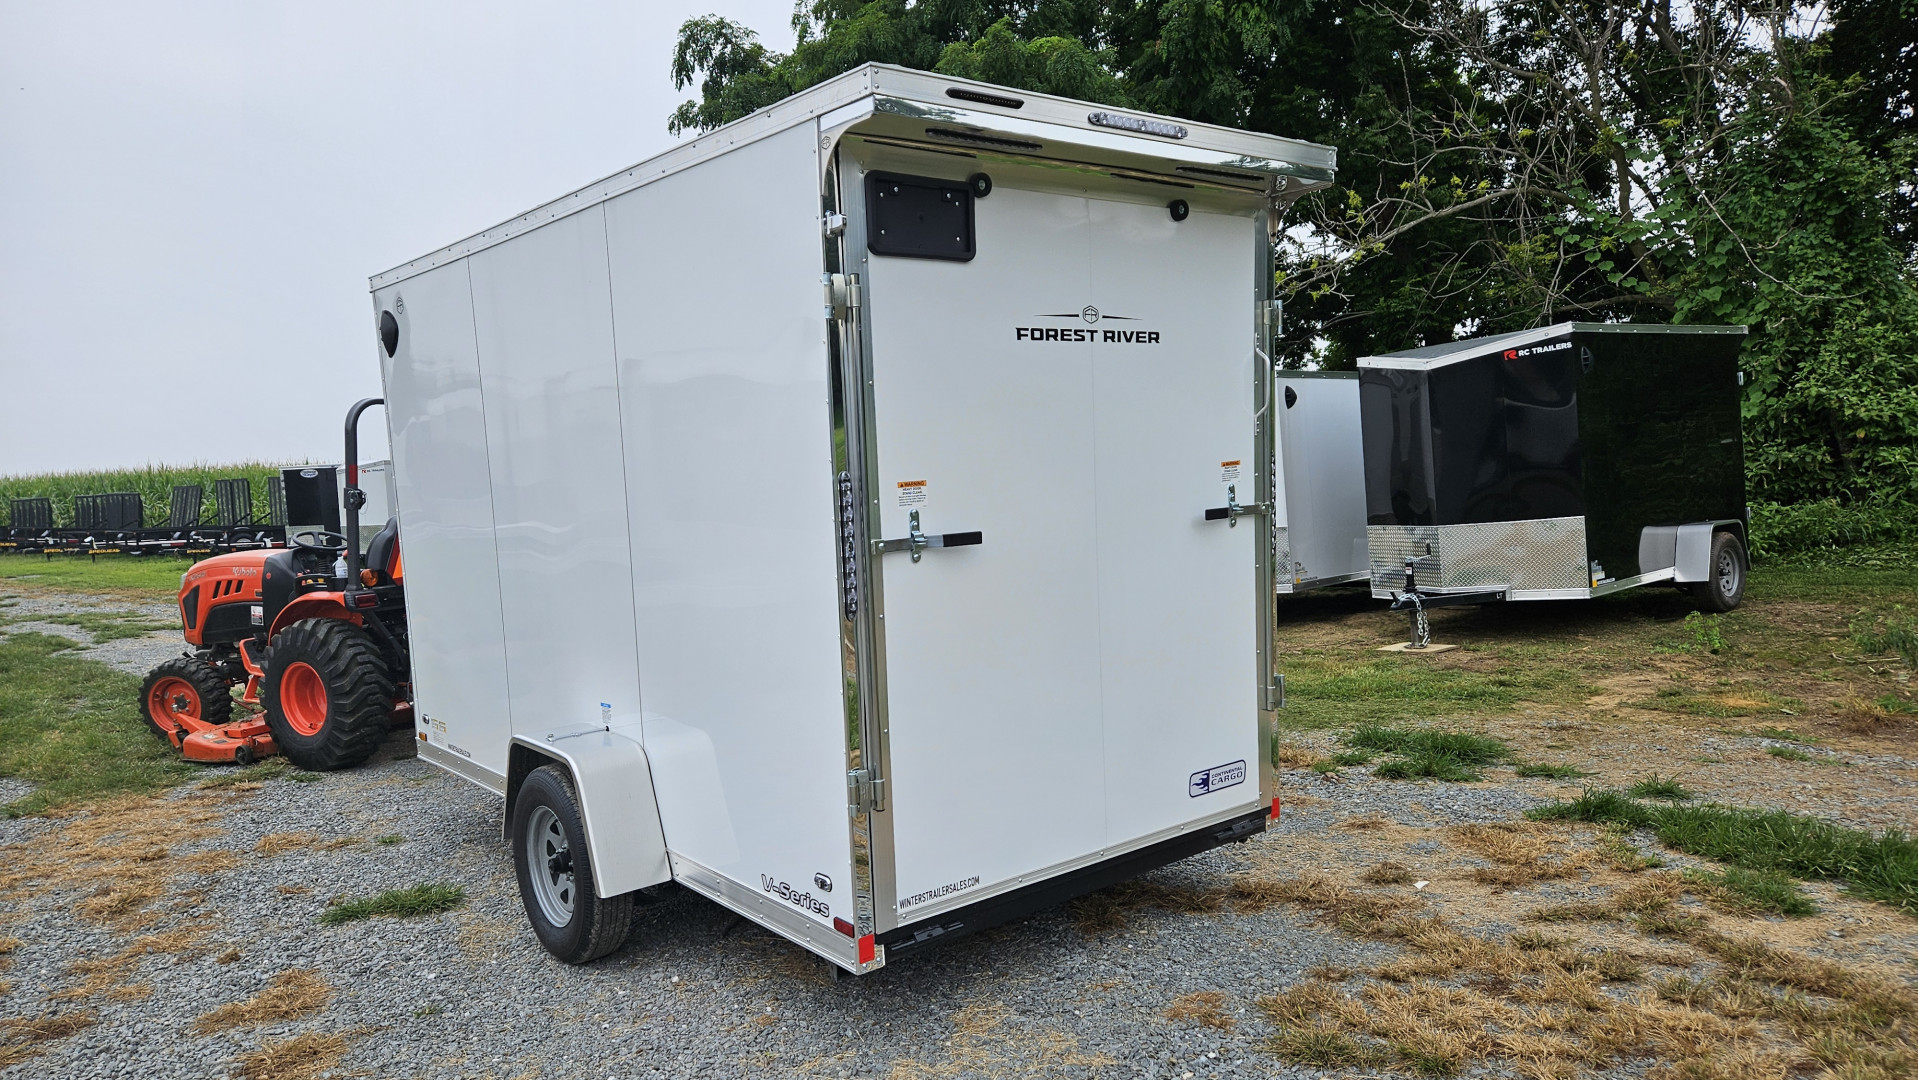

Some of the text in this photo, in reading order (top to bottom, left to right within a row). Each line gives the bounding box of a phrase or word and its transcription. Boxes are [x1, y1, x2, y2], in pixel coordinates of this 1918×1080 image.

[1015, 327, 1160, 344] FOREST RIVER
[1518, 348, 1530, 357] RC
[1531, 341, 1573, 354] TRAILERS
[232, 566, 257, 576] Kubota
[1211, 766, 1243, 778] CONTINENTAL
[1211, 770, 1243, 786] CARGO
[761, 873, 830, 918] V-Series
[898, 875, 980, 910] WINTERSTRAILERSALES.COM
